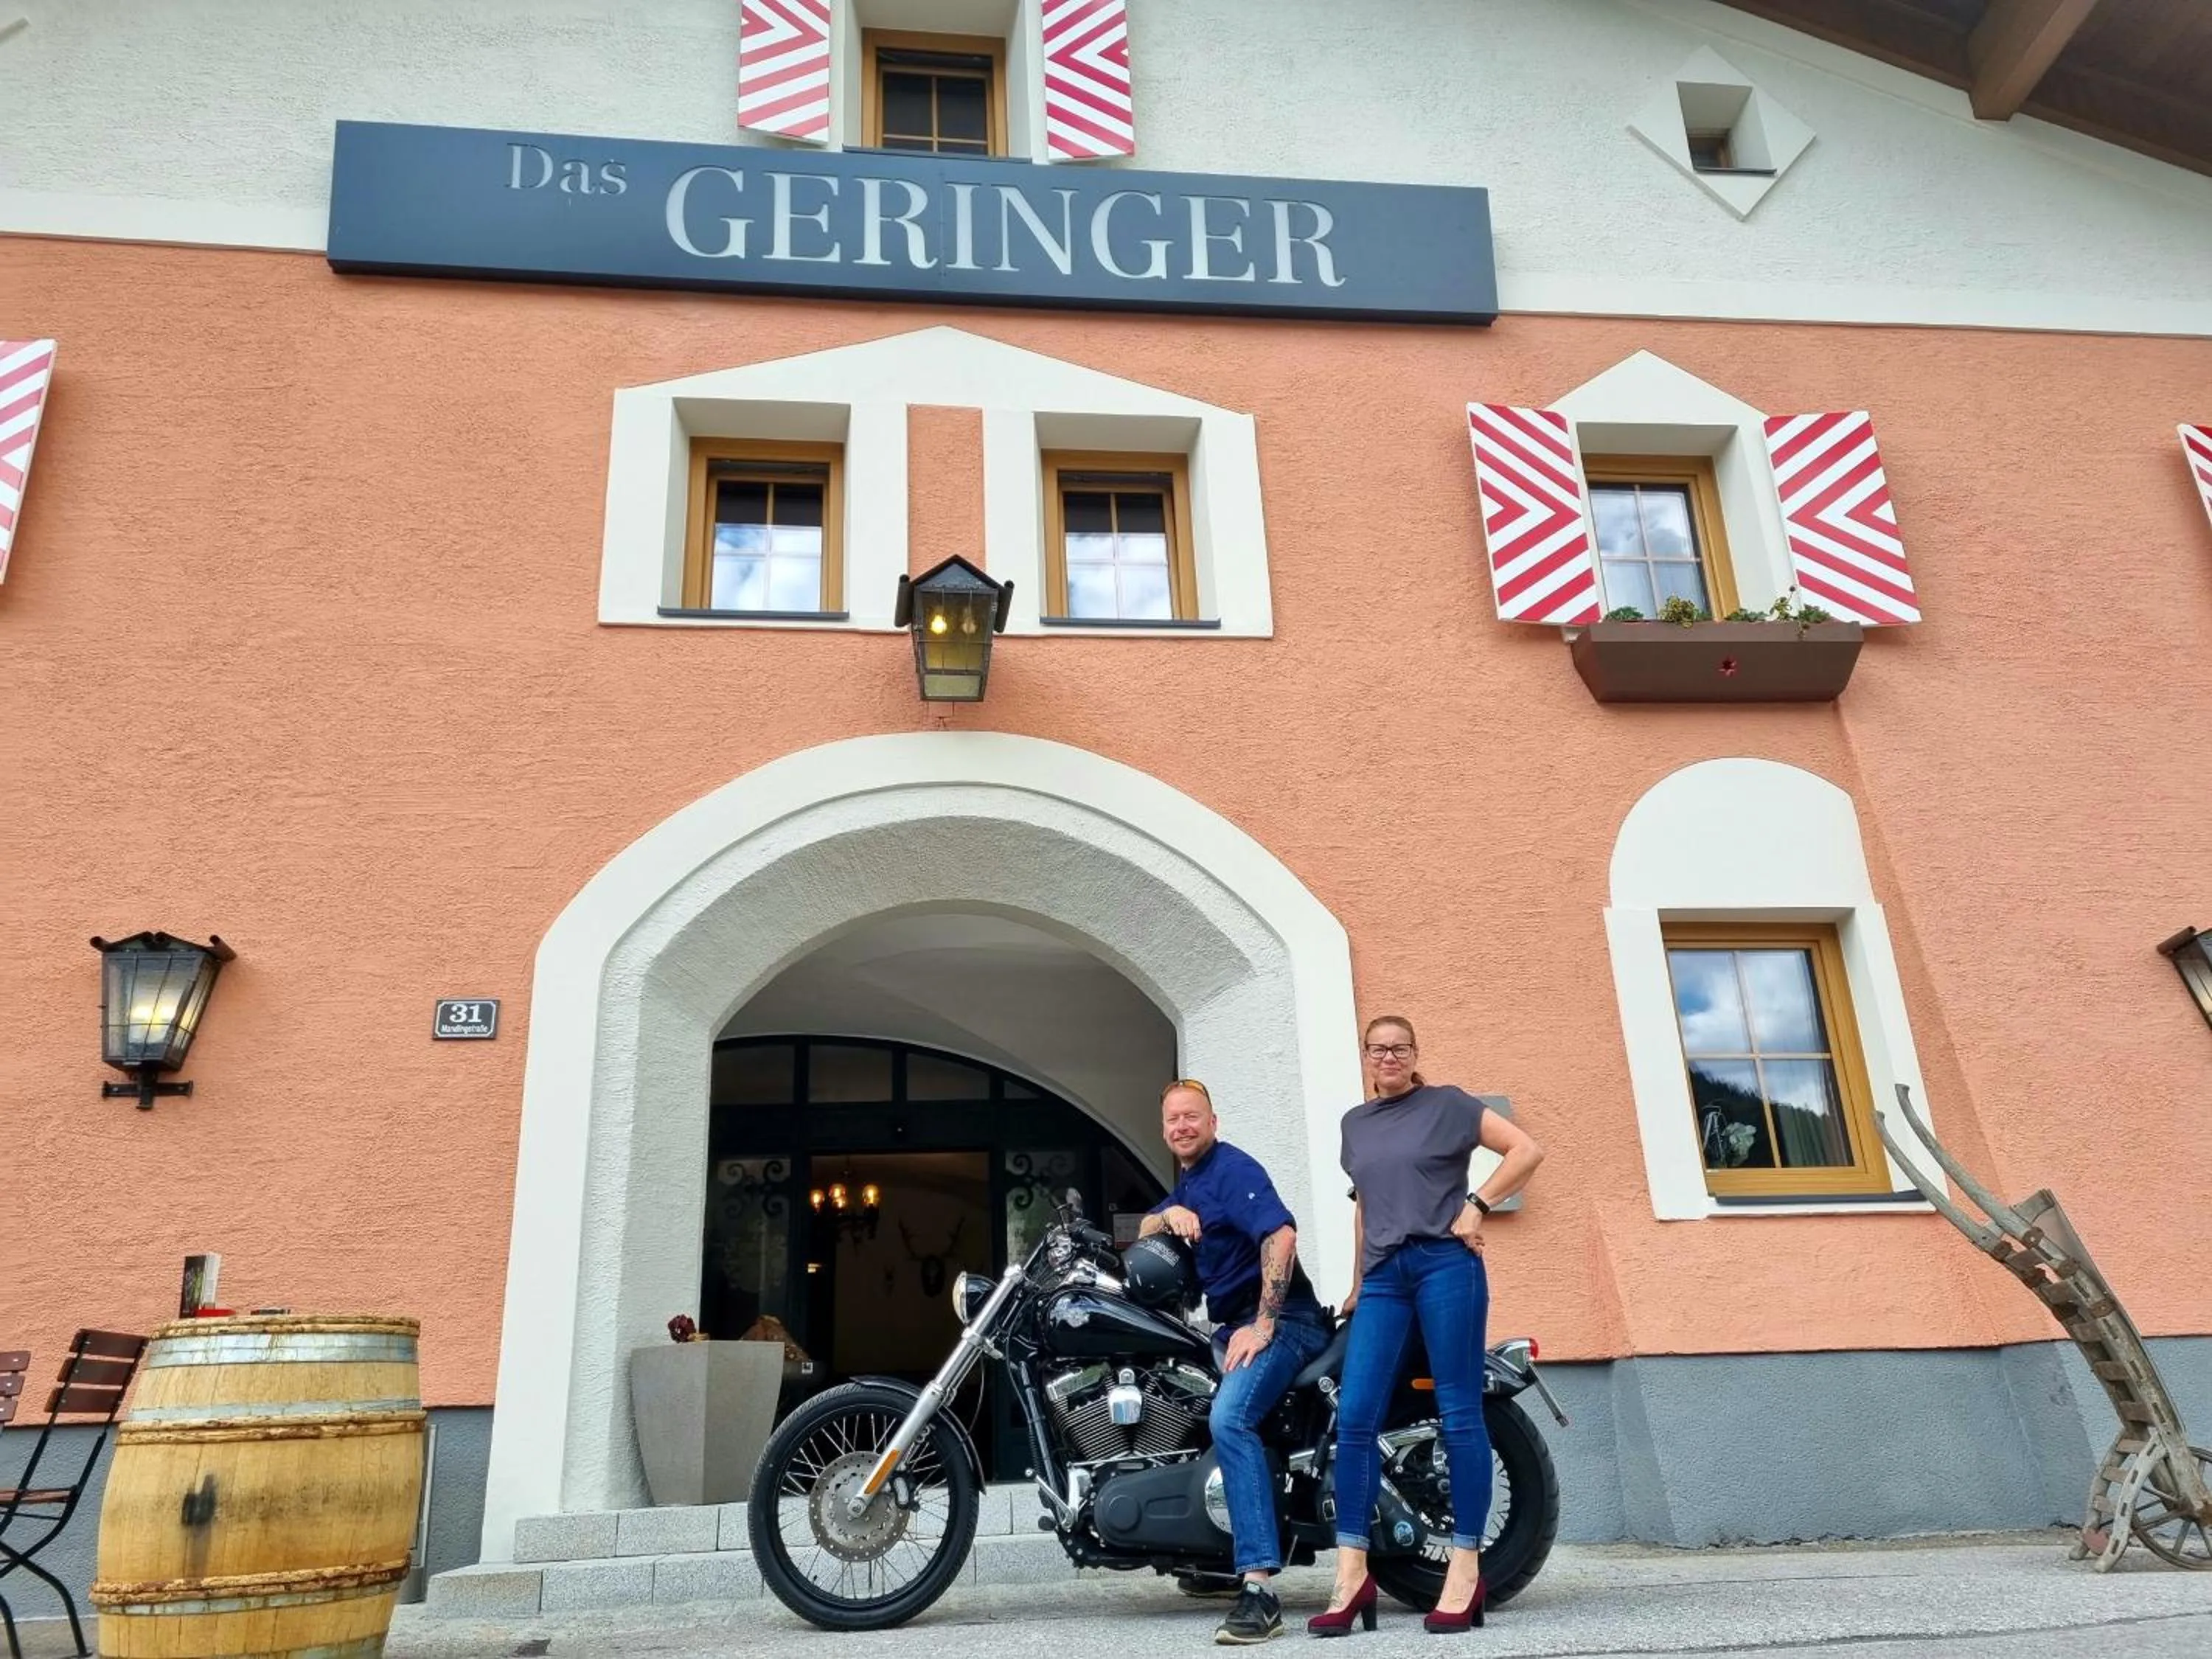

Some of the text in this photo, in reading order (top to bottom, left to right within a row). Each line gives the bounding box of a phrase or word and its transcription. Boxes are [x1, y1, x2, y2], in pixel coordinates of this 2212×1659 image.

[505, 142, 1346, 288] Das GERINGER
[449, 1004, 482, 1023] 31
